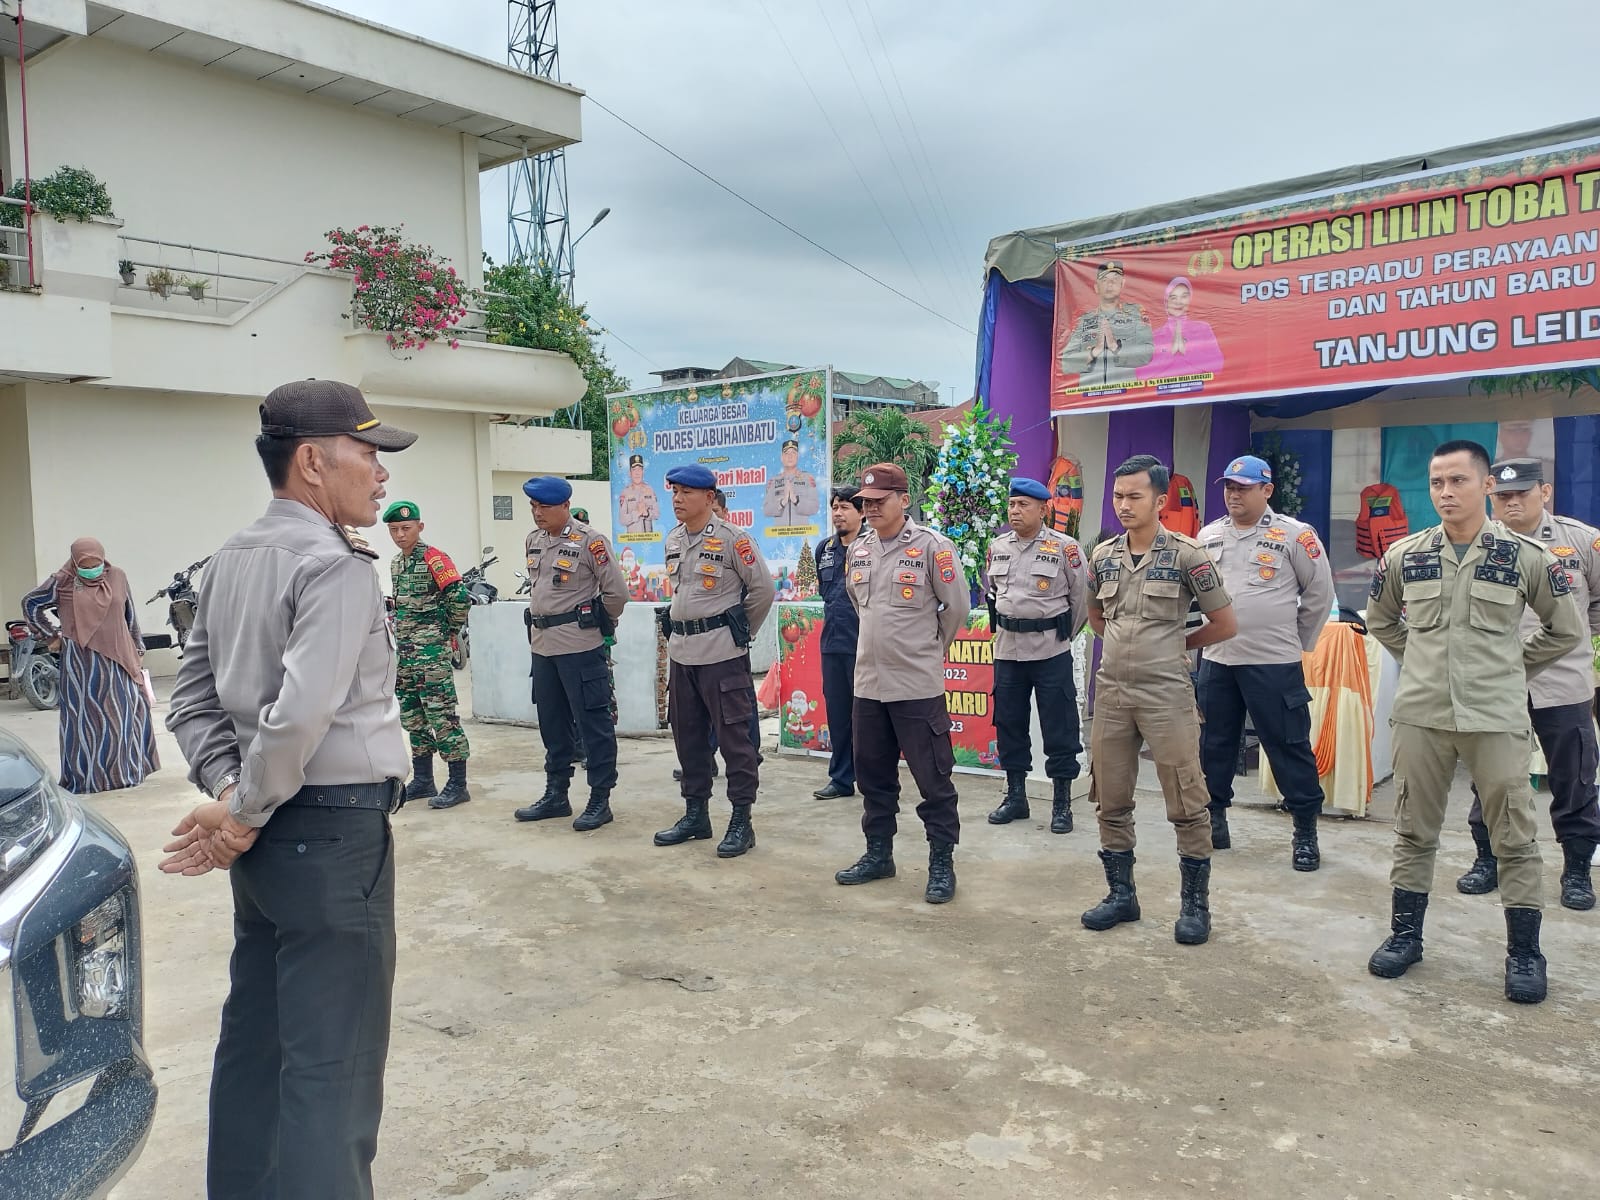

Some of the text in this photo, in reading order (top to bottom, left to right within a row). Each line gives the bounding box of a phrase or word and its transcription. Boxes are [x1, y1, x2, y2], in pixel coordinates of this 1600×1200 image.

[1232, 168, 1600, 271] OPERASI LILIN TOBA T
[1241, 229, 1599, 304] POS TERPADU PERAYAAN
[1328, 262, 1596, 320] DAN TAHUN BARU
[1314, 320, 1498, 369] TANJUNG
[679, 403, 747, 425] KELUARGA BESAR
[655, 421, 775, 452] POLRES LABUHANBATU
[736, 467, 766, 485] Natal
[558, 548, 580, 559] POLRI
[1256, 540, 1285, 553] POLRI
[699, 552, 724, 562] POLRI
[899, 559, 924, 569] POLRI
[1035, 554, 1059, 565] POLRI
[1147, 570, 1180, 580] POL PP
[1477, 567, 1517, 584] POL PP
[949, 640, 995, 665] NATA
